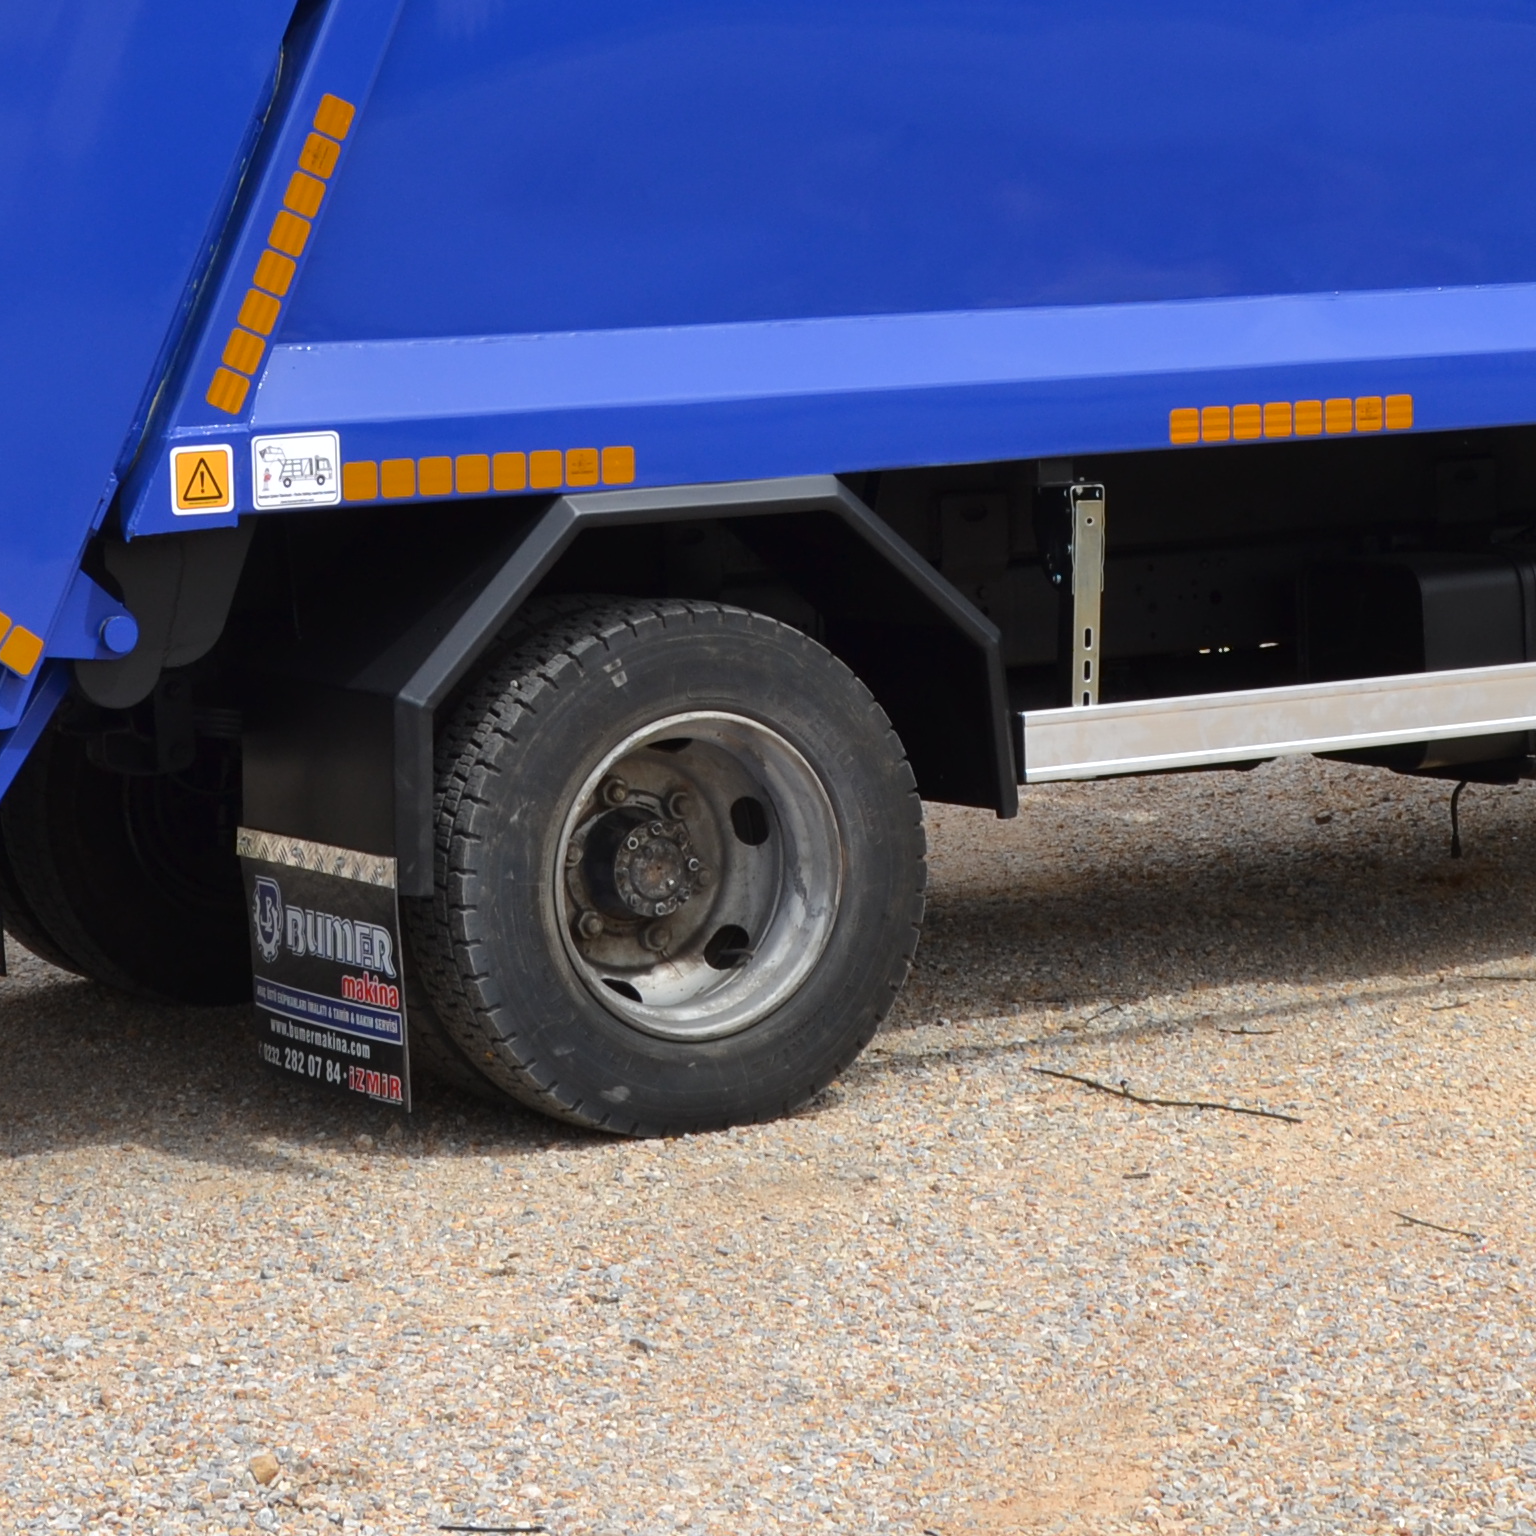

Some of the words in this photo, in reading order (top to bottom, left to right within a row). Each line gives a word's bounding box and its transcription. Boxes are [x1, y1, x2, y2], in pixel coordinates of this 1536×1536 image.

[285, 904, 398, 979] BUMER
[341, 971, 400, 1011] makina
[270, 1017, 371, 1060] www.bumermakina.com
[284, 1047, 305, 1075] 282
[308, 1054, 322, 1079] 07
[325, 1059, 341, 1086] 84
